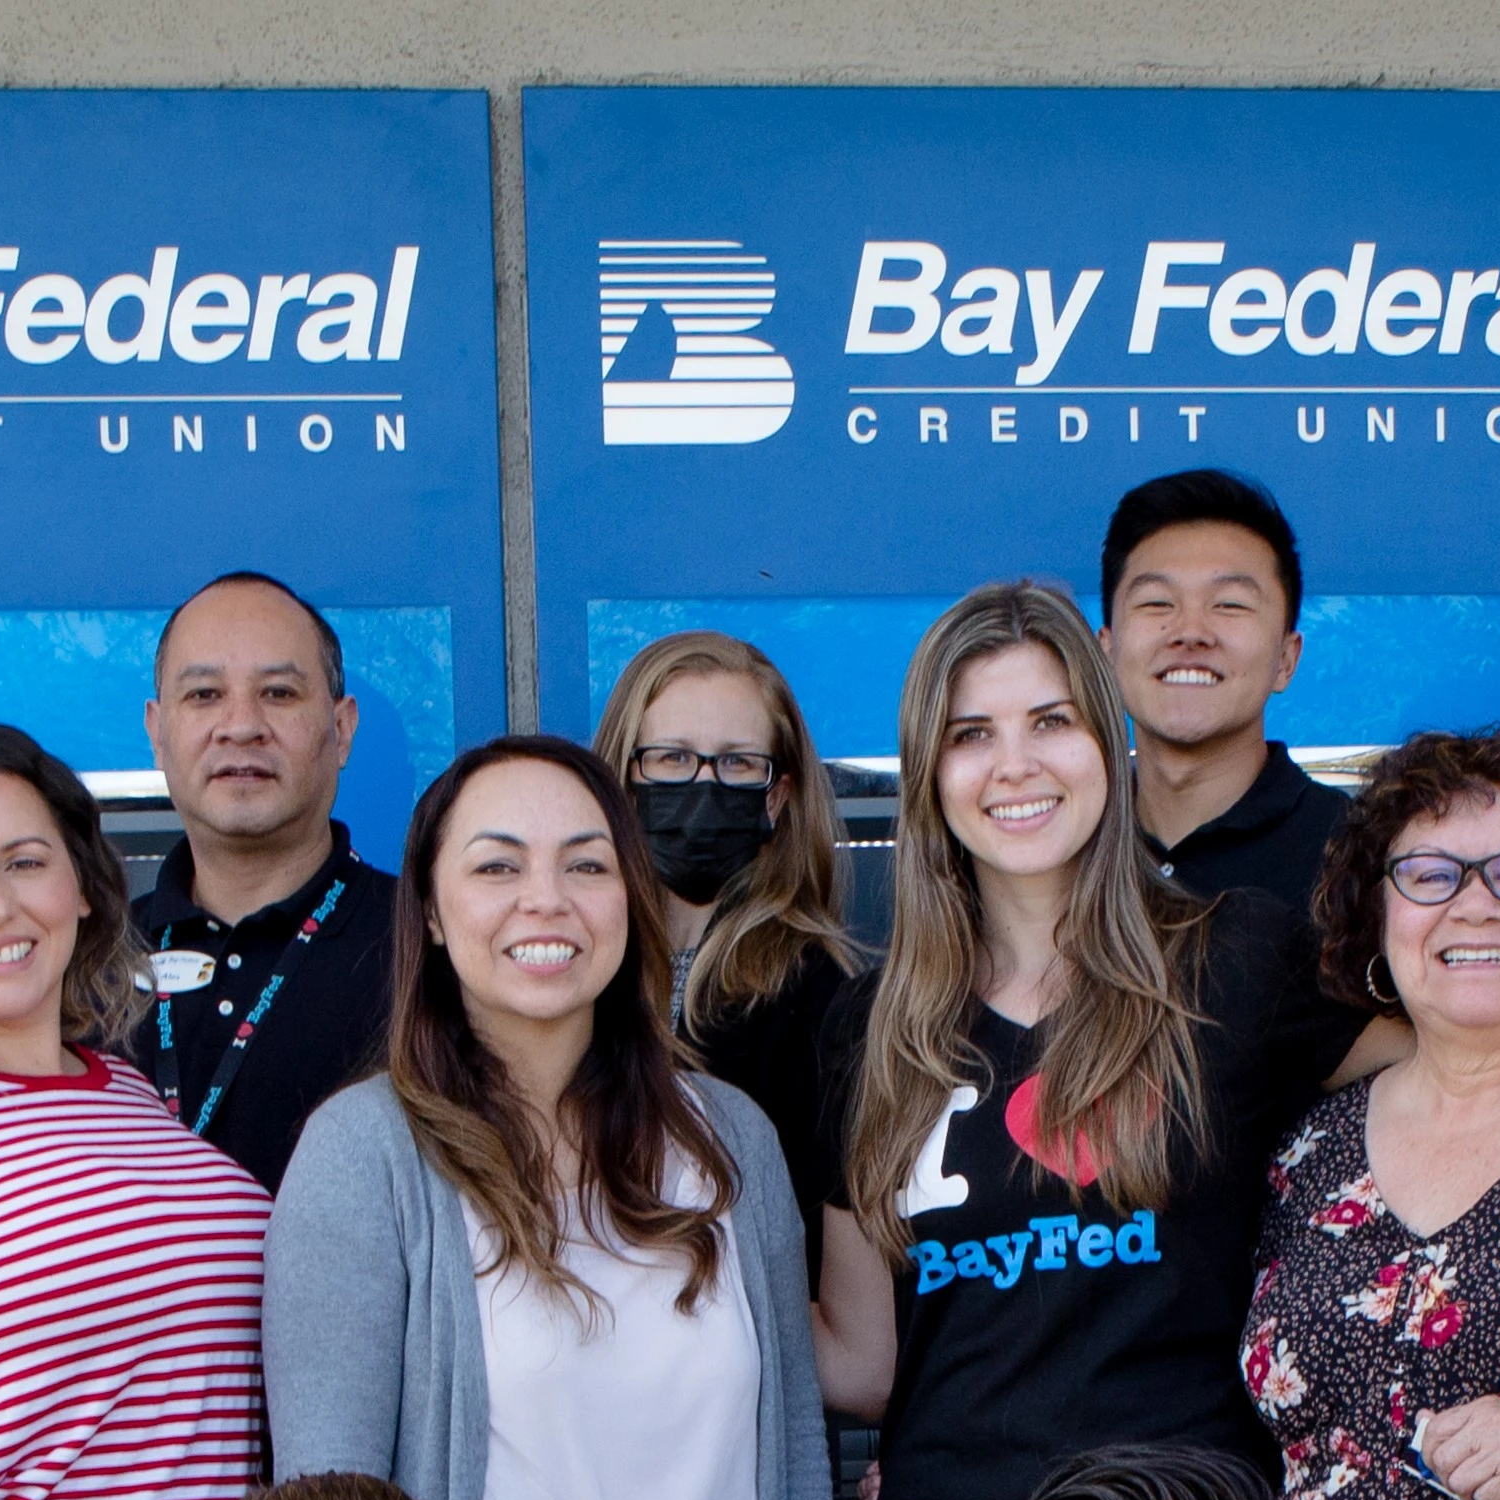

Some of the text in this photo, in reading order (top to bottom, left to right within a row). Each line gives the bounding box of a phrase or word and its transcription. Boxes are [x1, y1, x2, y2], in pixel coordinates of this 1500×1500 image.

[844, 240, 1105, 387] Bay
[98, 413, 406, 454] UNION
[846, 405, 1207, 445] CREDIT
[905, 1209, 1162, 1295] BayFed
